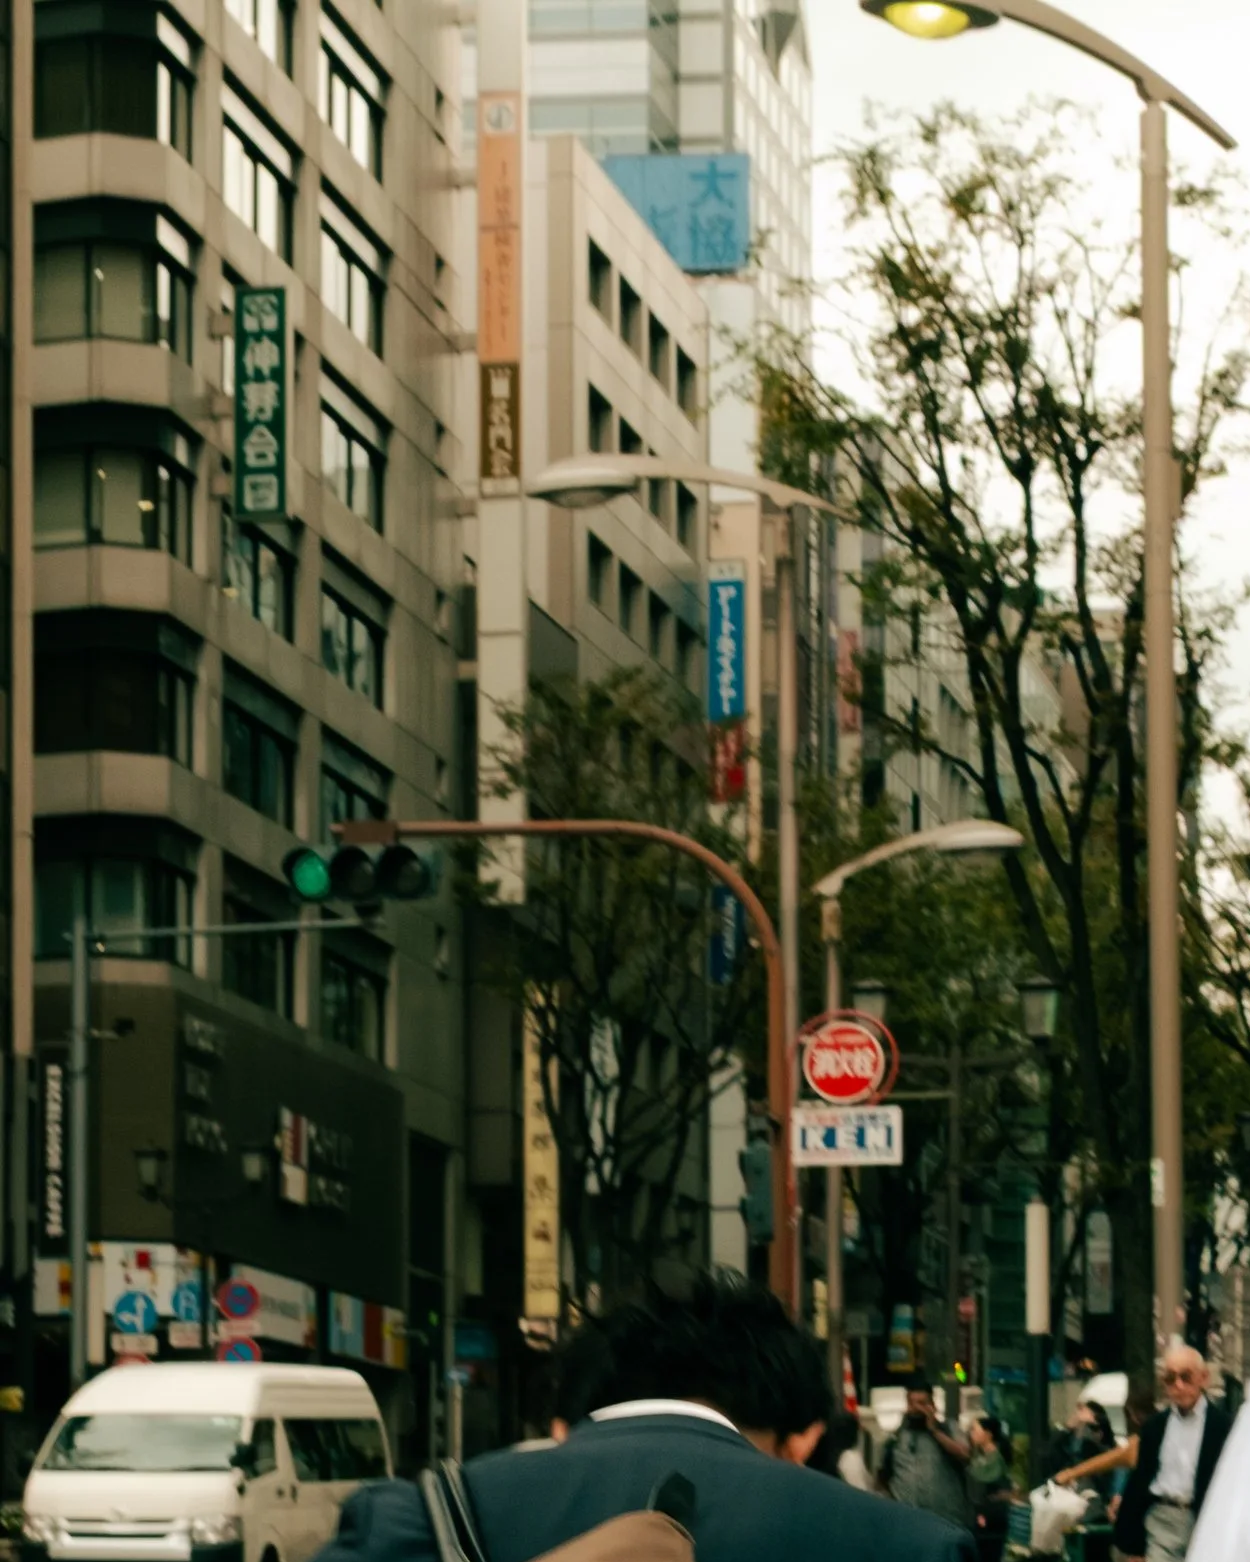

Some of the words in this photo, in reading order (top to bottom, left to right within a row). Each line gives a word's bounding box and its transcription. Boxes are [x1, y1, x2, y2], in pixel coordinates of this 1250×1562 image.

[813, 1047, 875, 1078] 消火栓
[806, 1126, 888, 1149] KEN
